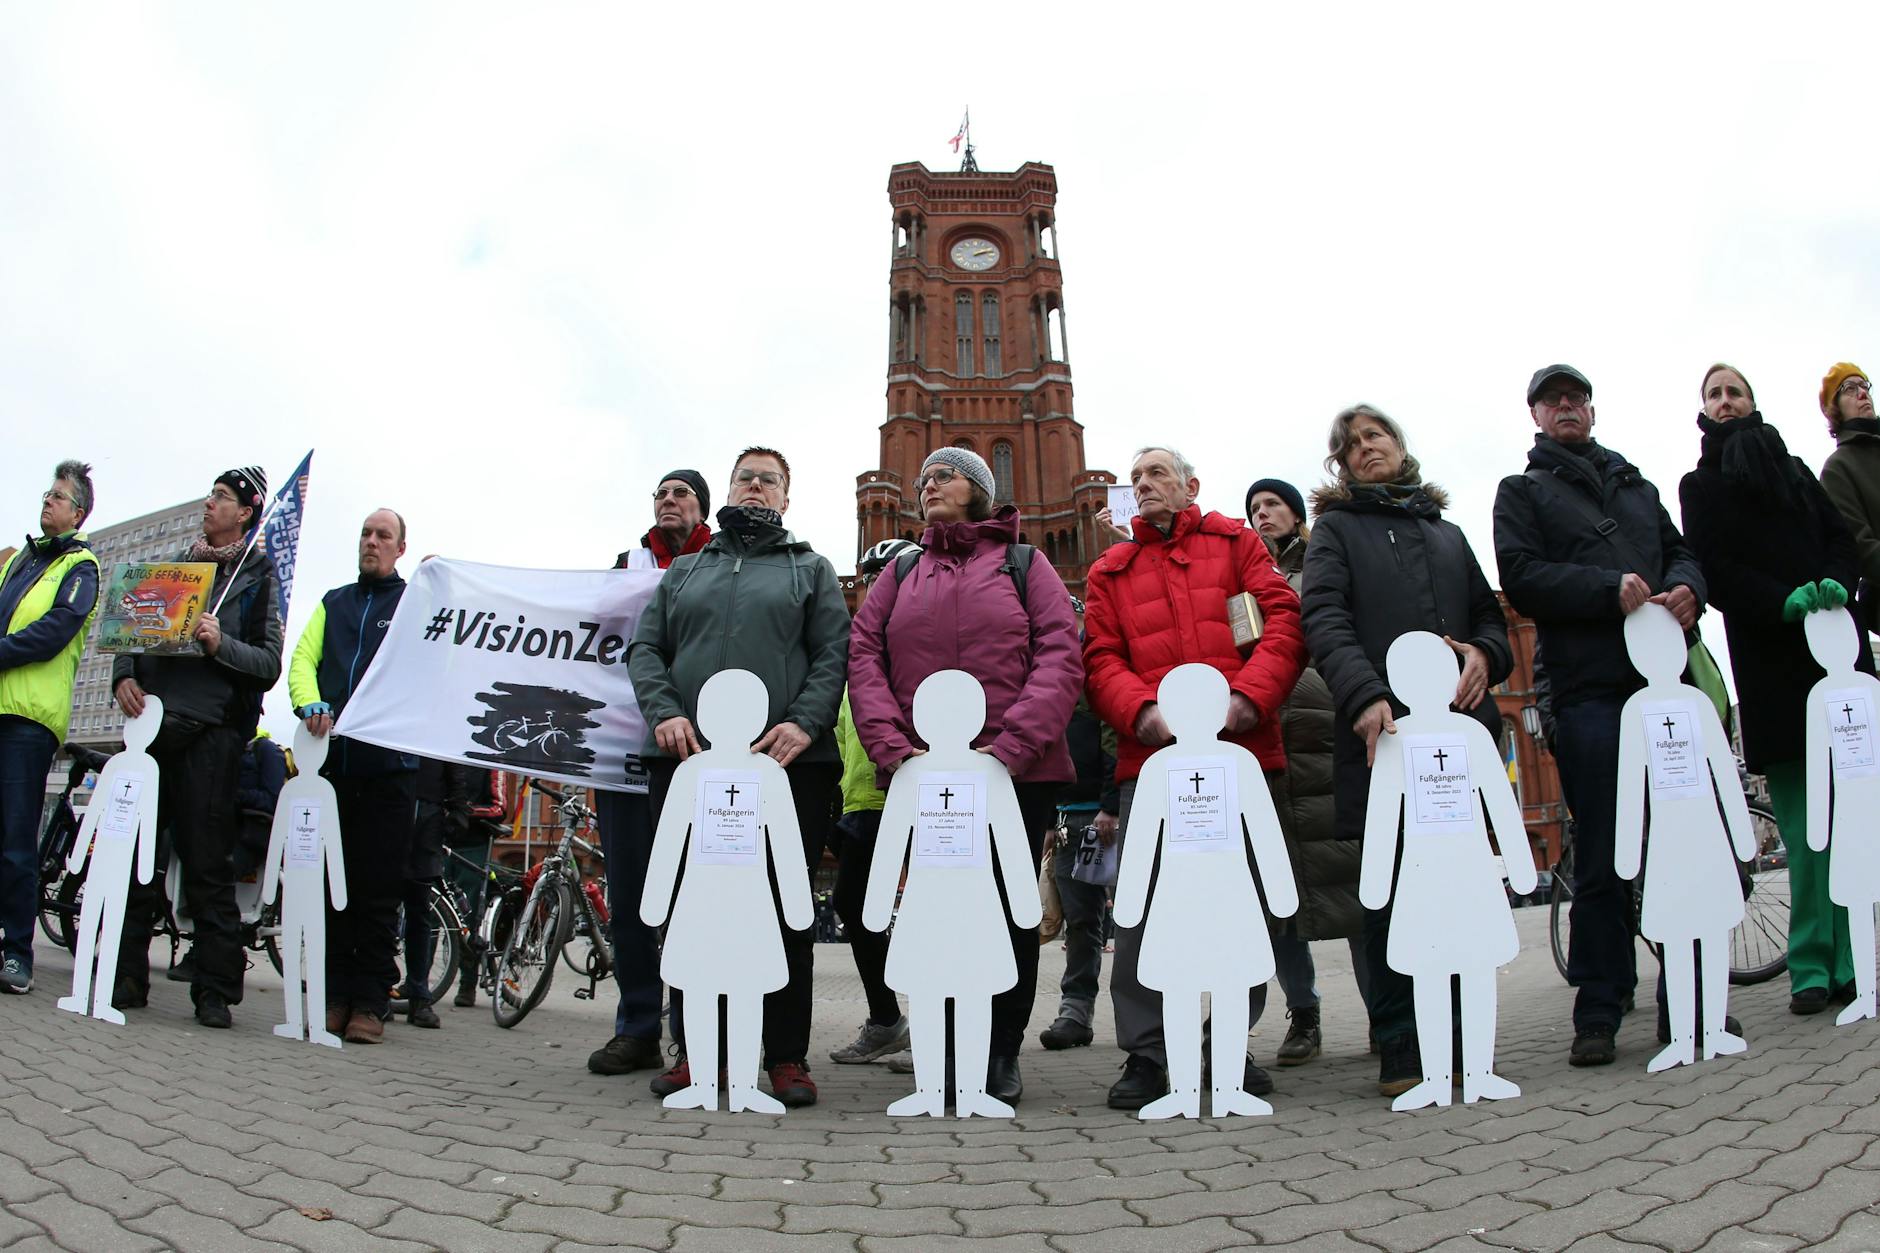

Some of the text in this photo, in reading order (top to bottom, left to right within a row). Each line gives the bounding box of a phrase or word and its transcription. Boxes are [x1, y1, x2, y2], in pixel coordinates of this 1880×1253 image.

[123, 568, 152, 580] AUTOS
[1656, 740, 1689, 750] Fußgänger
[1419, 774, 1466, 783] Fußgängerin
[1178, 795, 1220, 804] Fußgänger
[708, 808, 755, 817] Fußgängerin
